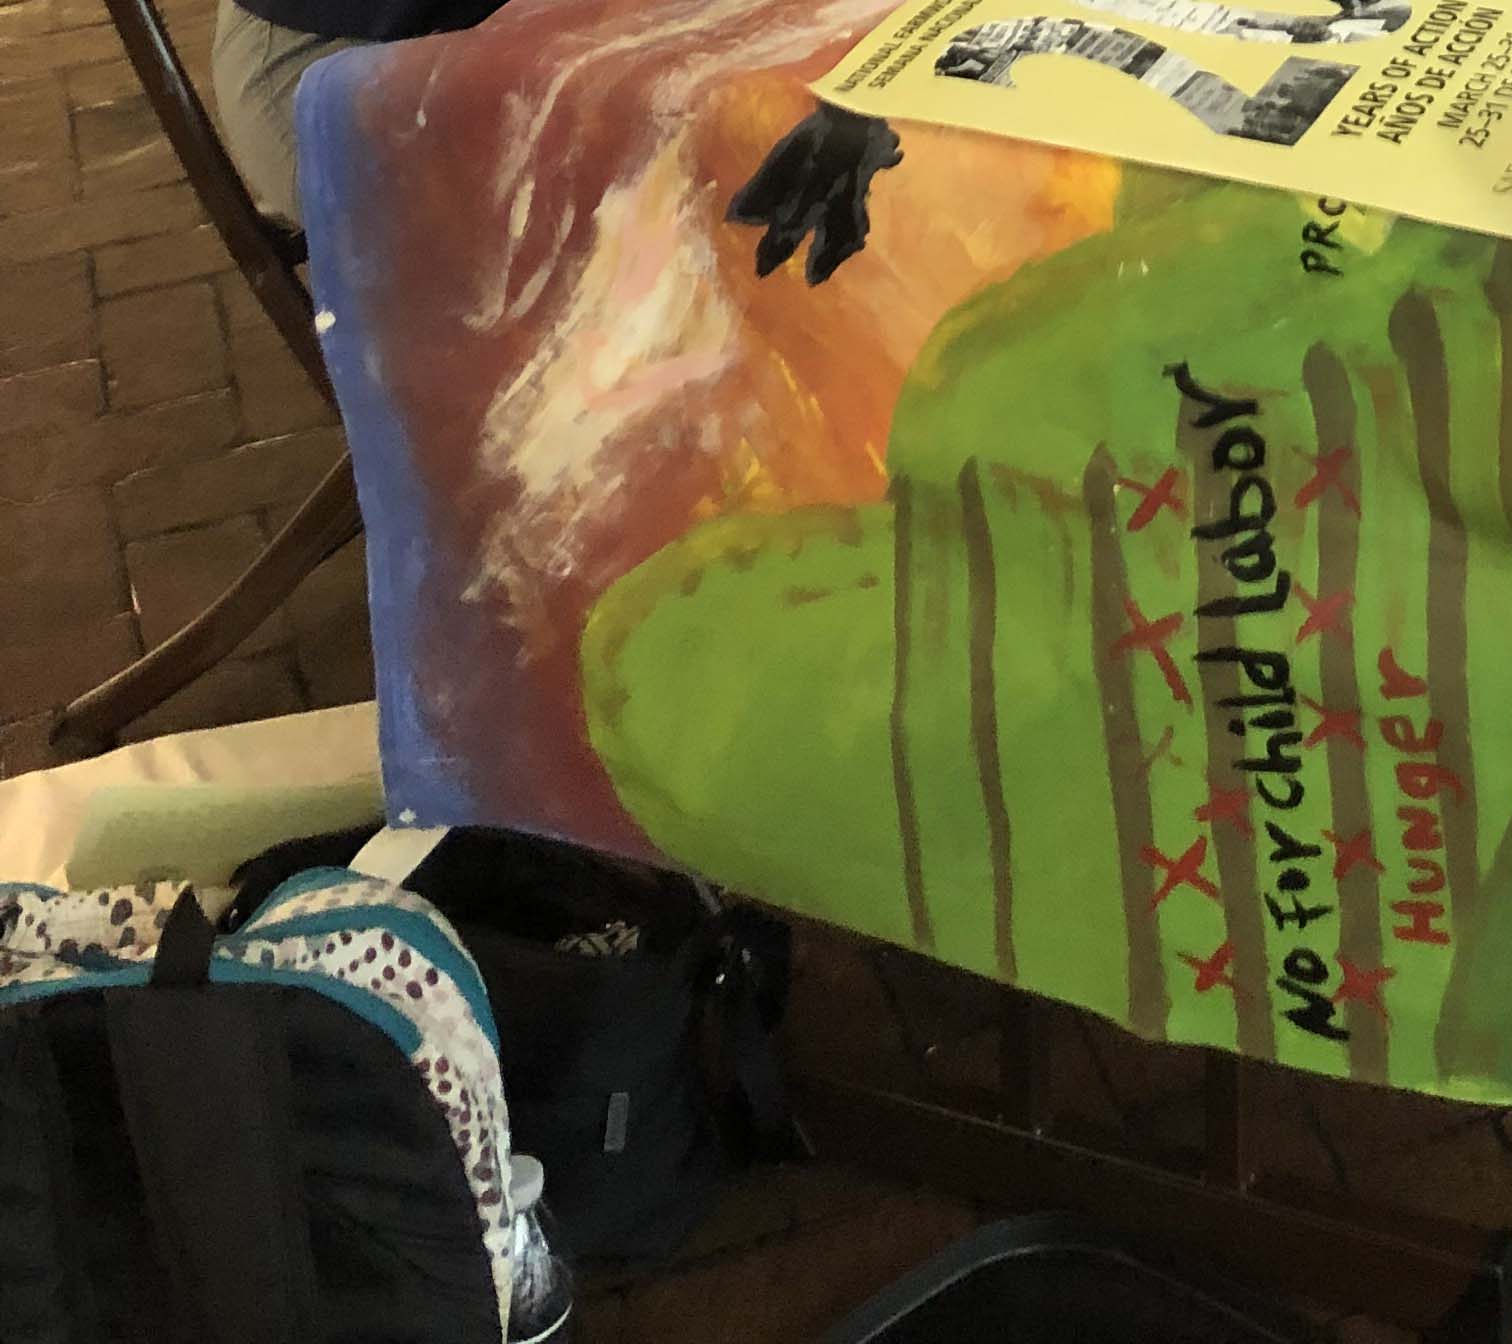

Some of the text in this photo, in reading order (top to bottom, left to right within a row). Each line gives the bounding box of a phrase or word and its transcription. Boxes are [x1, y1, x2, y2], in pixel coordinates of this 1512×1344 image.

[834, 43, 902, 92] NATIONAL
[868, 44, 927, 89] SEMANA
[1376, 6, 1504, 144] AÑOS DE ACCIÓN
[1331, 81, 1398, 136] YEARS
[1382, 57, 1417, 81] OF
[1437, 72, 1497, 129] MARCH
